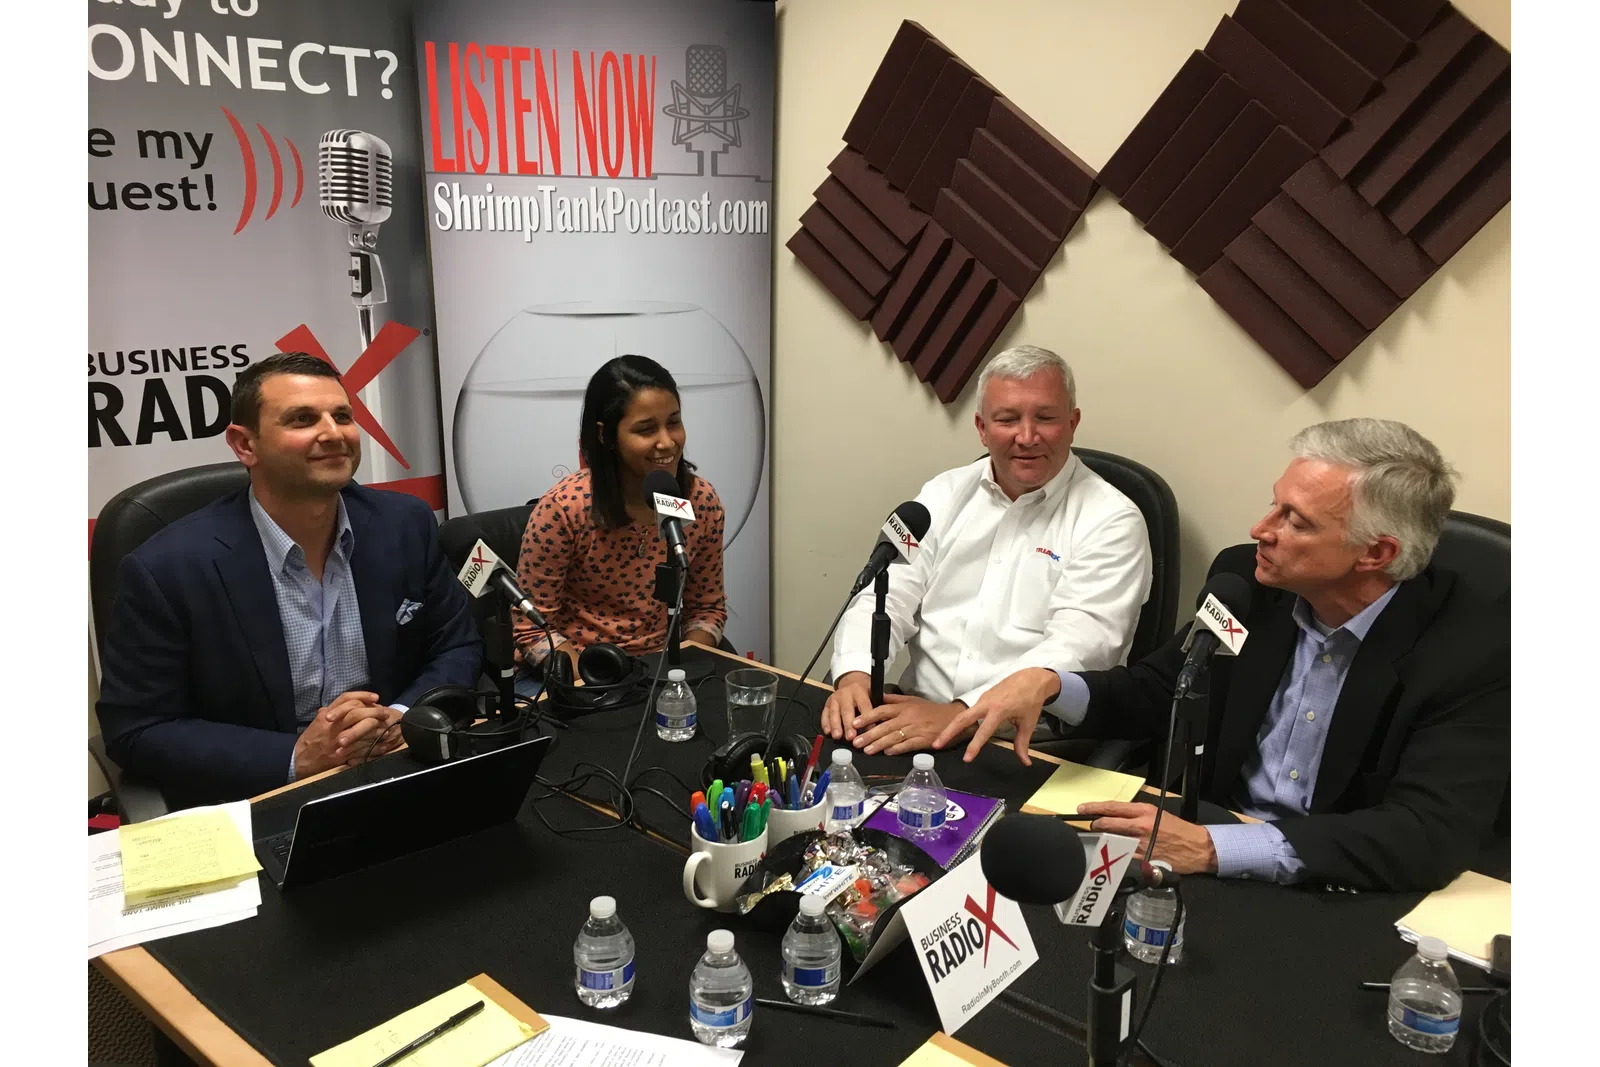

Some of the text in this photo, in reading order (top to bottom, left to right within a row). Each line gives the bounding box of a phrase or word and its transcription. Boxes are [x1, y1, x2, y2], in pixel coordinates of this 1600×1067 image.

[88, 24, 398, 100] ONNECT?
[425, 41, 656, 178] LISTEN NOW
[137, 129, 213, 169] my
[434, 182, 768, 243] ShrimpTankPodcast.com
[920, 912, 962, 951] BUSINESS
[961, 959, 1022, 1015] RadioInMyBooth.com
